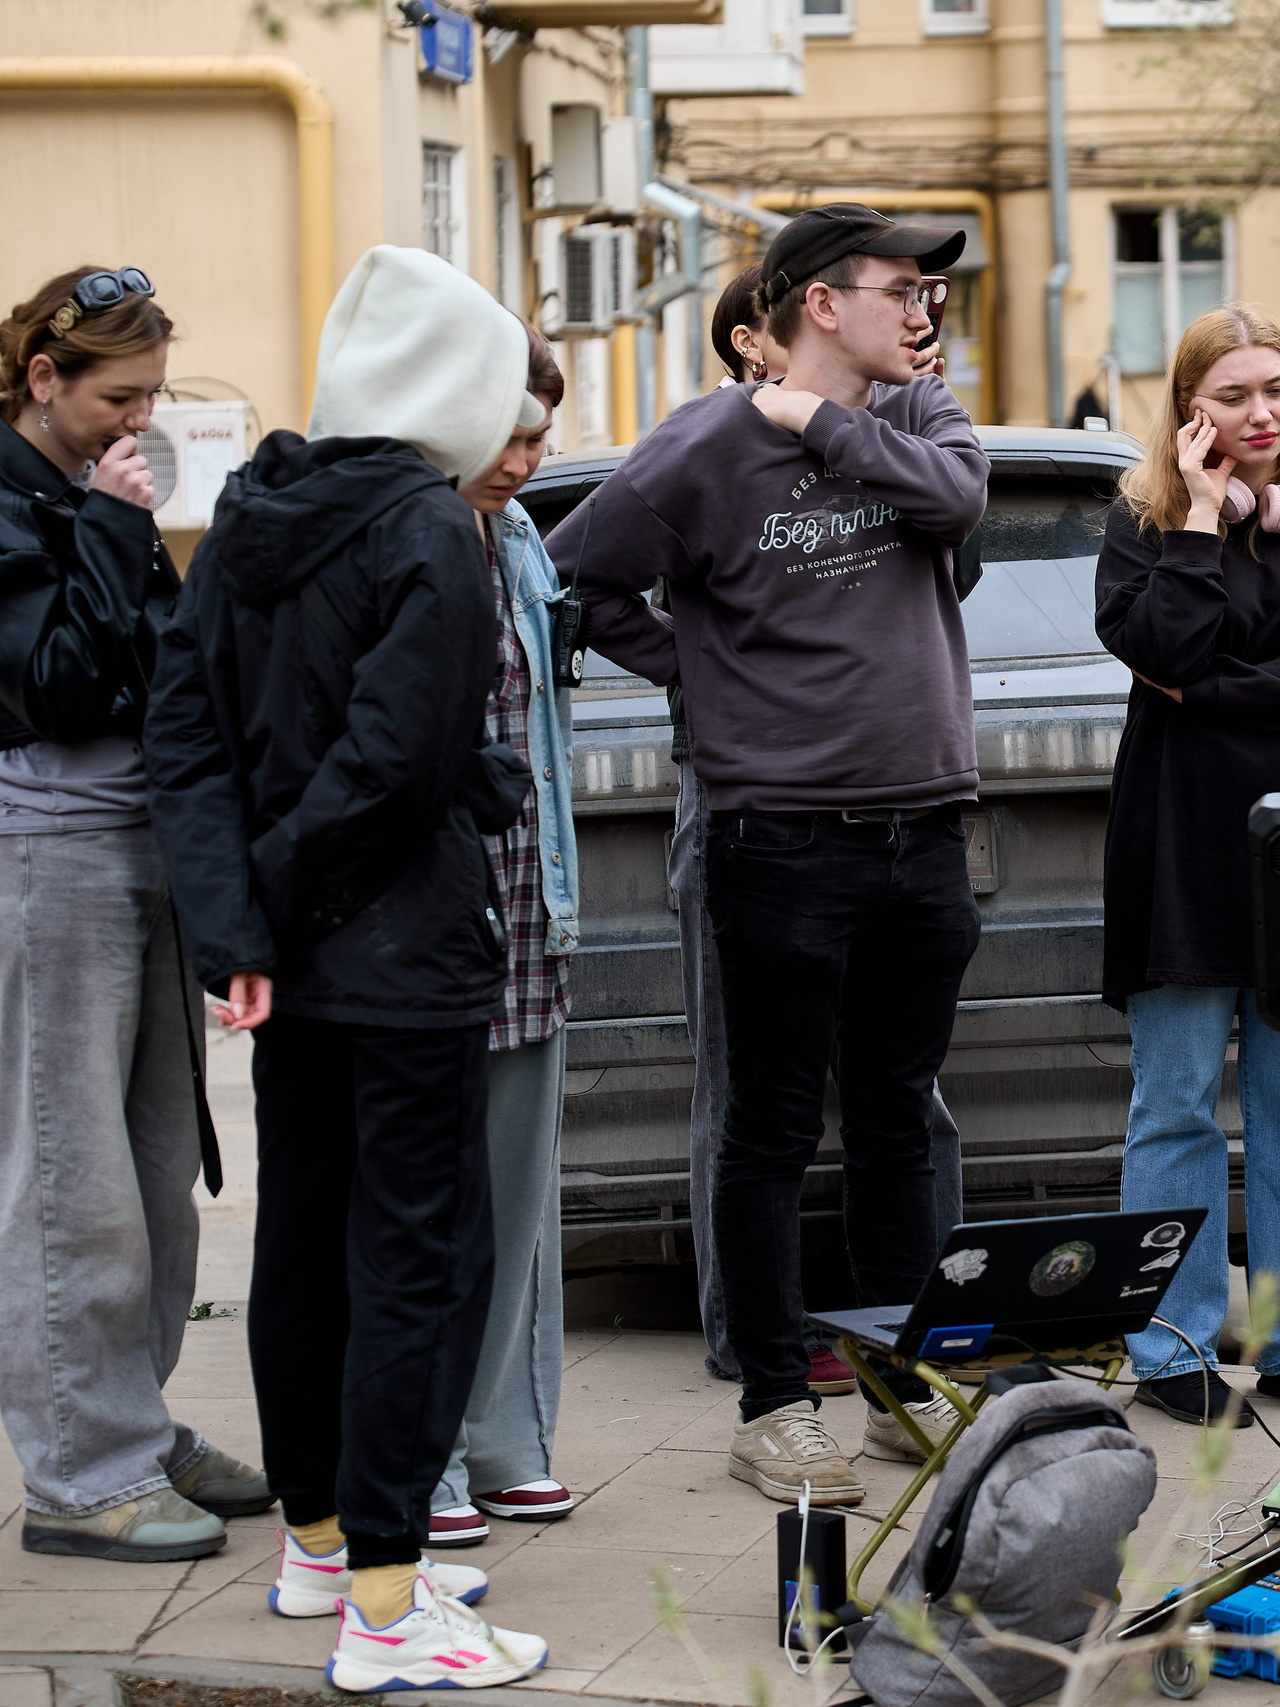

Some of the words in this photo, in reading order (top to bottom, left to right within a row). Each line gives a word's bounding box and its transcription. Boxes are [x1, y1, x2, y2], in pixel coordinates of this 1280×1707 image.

[789, 472, 817, 500] БЕЗ
[759, 511, 823, 554] Без
[786, 564, 804, 574] БЕЗ
[807, 551, 863, 570] КОНЕЧНОГО
[864, 541, 902, 557] ПУНКТА
[815, 559, 878, 579] НАЗНАЧЕНИЯ
